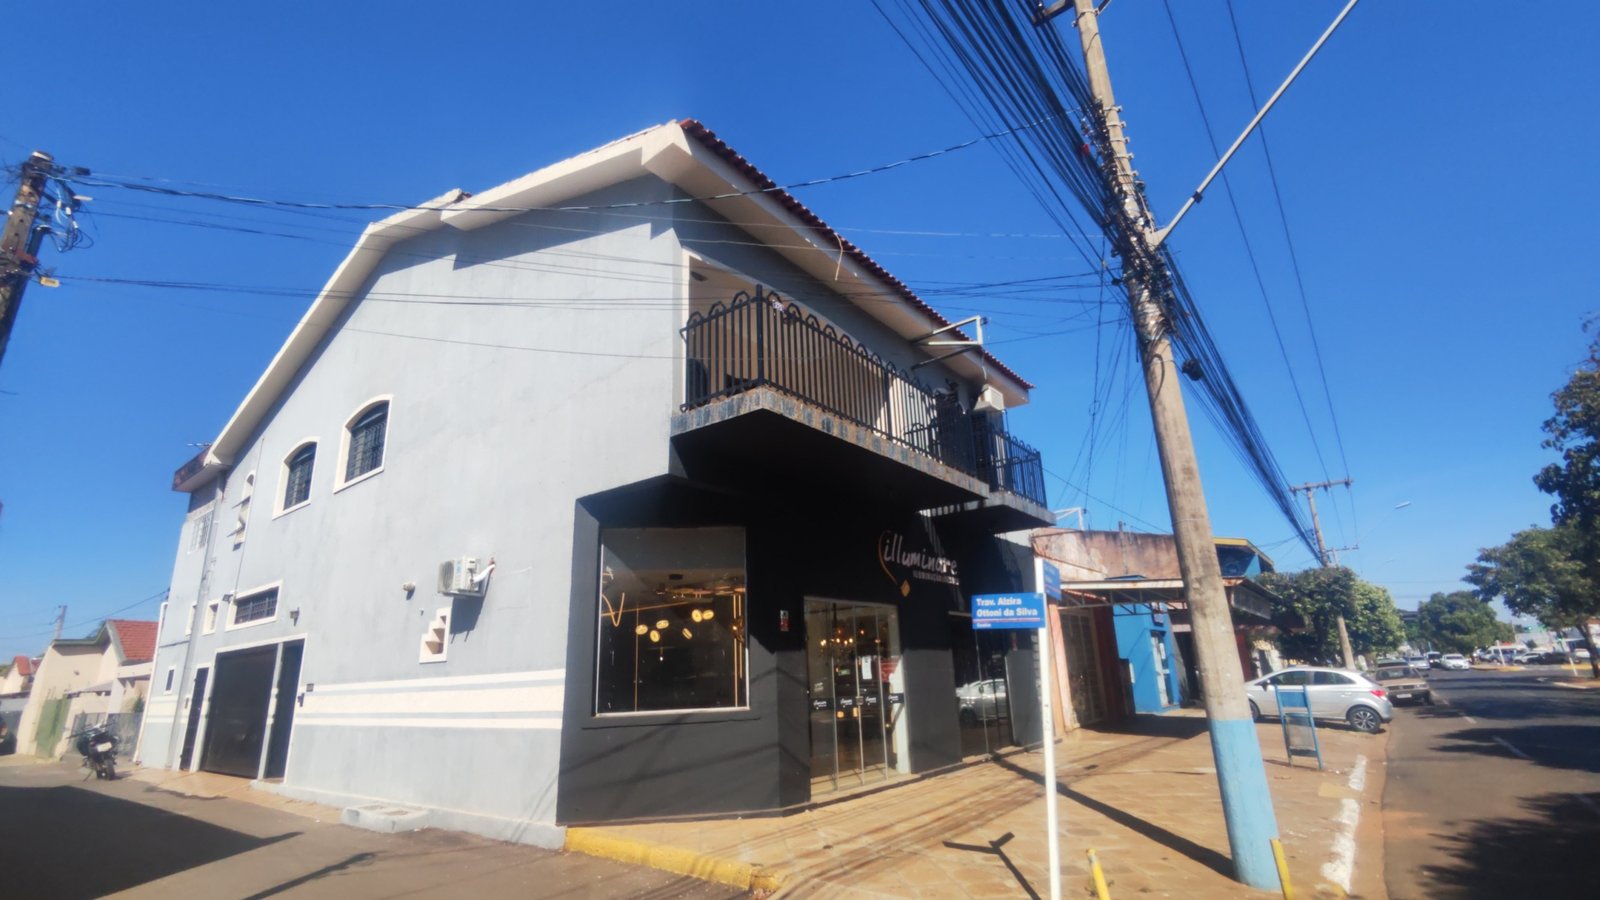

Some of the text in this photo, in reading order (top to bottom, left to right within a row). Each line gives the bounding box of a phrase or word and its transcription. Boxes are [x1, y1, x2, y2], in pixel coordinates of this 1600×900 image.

[883, 532, 958, 575] illuminare
[976, 598, 995, 606] Trav.
[976, 607, 1037, 617] Ottoni da Silva
